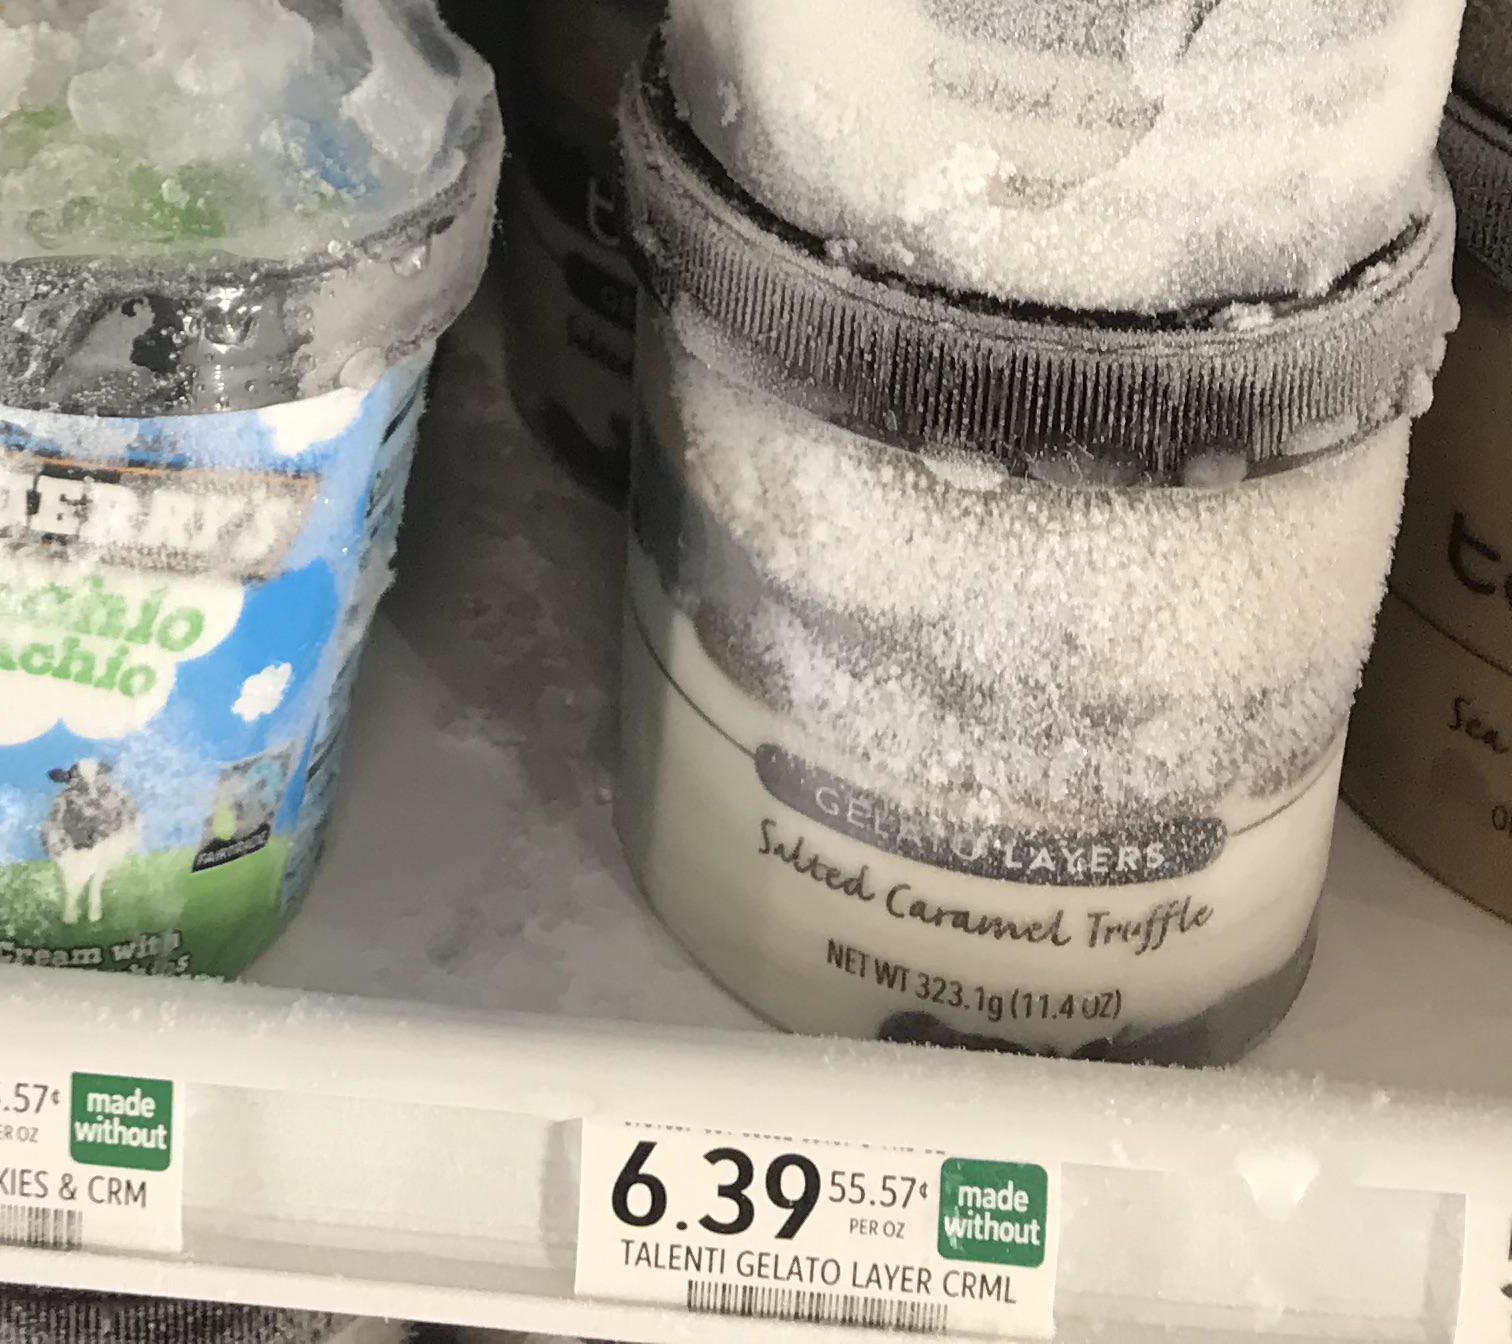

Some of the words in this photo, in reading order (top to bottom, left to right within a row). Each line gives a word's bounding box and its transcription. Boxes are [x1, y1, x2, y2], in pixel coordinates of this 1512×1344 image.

[814, 785, 990, 862] GELATO
[1005, 843, 1165, 874] LAYERS
[758, 817, 875, 902] Salted
[886, 883, 1071, 947] Caramel
[1087, 895, 1215, 957] Truffle
[827, 938, 867, 978] NET
[874, 957, 911, 993] WT
[916, 971, 1005, 1023] 323.1g
[1010, 989, 1074, 1022] (11.4
[1082, 988, 1123, 1021] OZ)
[87, 1088, 156, 1118] made
[16, 1126, 39, 1143] OZ
[74, 1115, 167, 1151] without
[58, 1173, 78, 1201] &
[88, 1175, 148, 1209] CRM
[612, 1140, 822, 1241] 6.39
[958, 1180, 1030, 1214] made
[849, 1218, 879, 1238] PER
[883, 1219, 906, 1239] OZ
[944, 1209, 1041, 1247] without
[620, 1239, 726, 1275] TALENTI
[736, 1250, 842, 1286] GELATO
[852, 1261, 932, 1296] LAYER
[943, 1269, 1017, 1305] CRML
